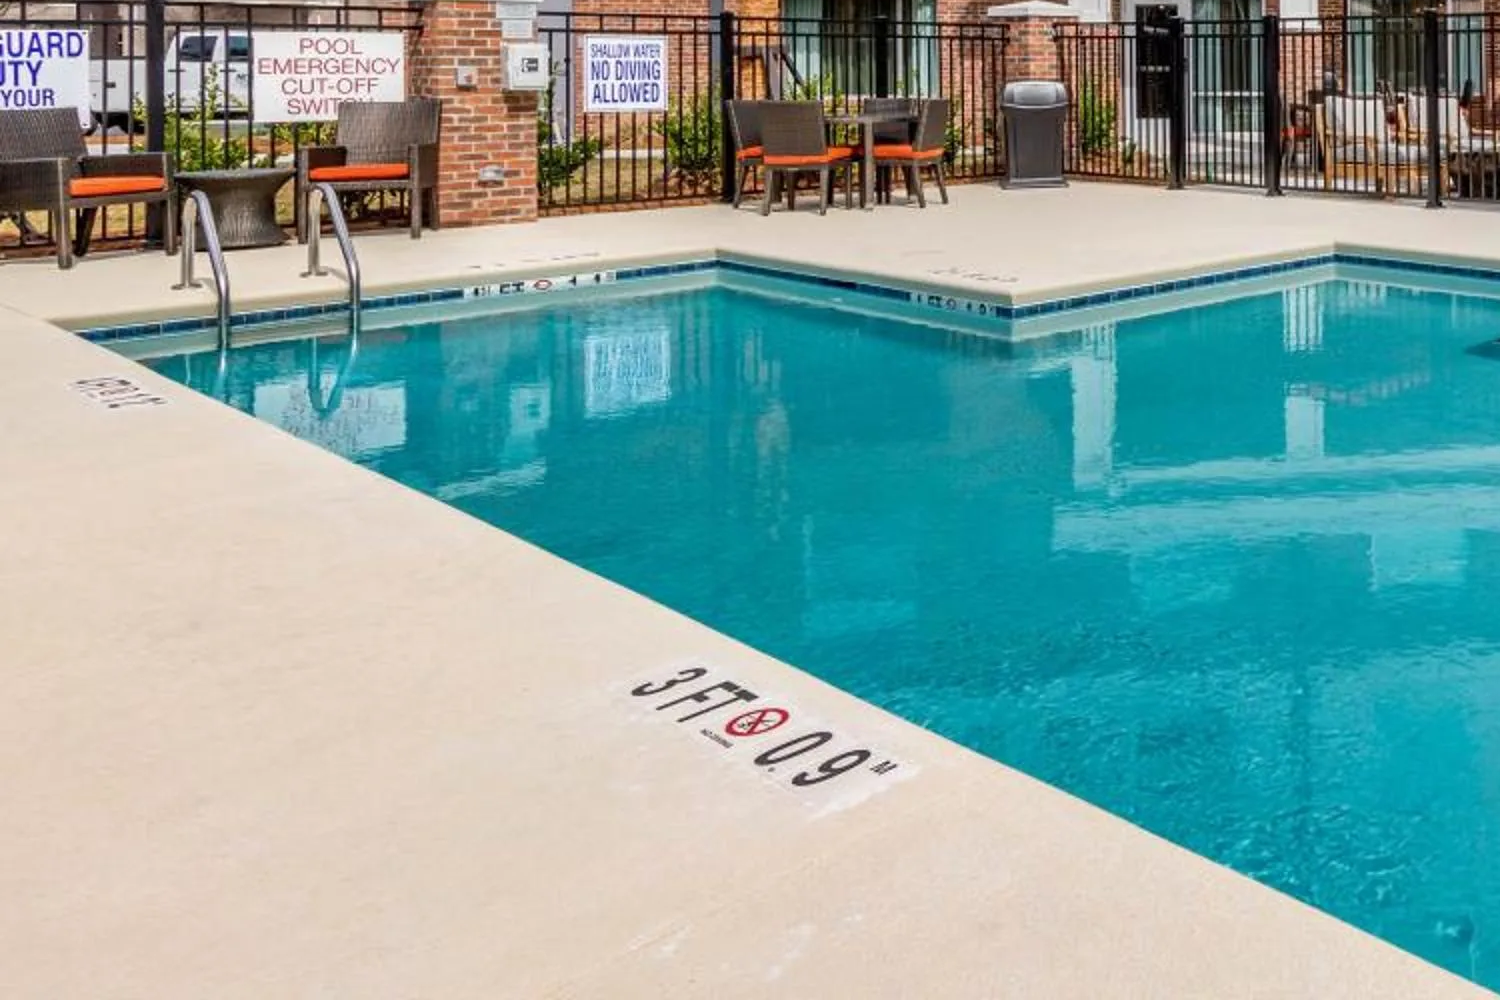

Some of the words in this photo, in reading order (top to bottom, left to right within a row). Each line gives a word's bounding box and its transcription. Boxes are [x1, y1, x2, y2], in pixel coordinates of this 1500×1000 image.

[0, 31, 83, 58] UARD
[299, 37, 363, 55] POOL
[591, 43, 631, 59] SHALLOW
[633, 43, 661, 59] WATER
[258, 57, 400, 75] EMERGENCY
[591, 60, 610, 81] NO
[615, 60, 661, 81] DIVING
[281, 77, 379, 95] CUT-OFF
[592, 82, 661, 104] ALLOWED
[0, 88, 55, 107] YOUR
[287, 98, 374, 115] SWIT
[631, 667, 708, 697] 3
[655, 680, 759, 723] FT
